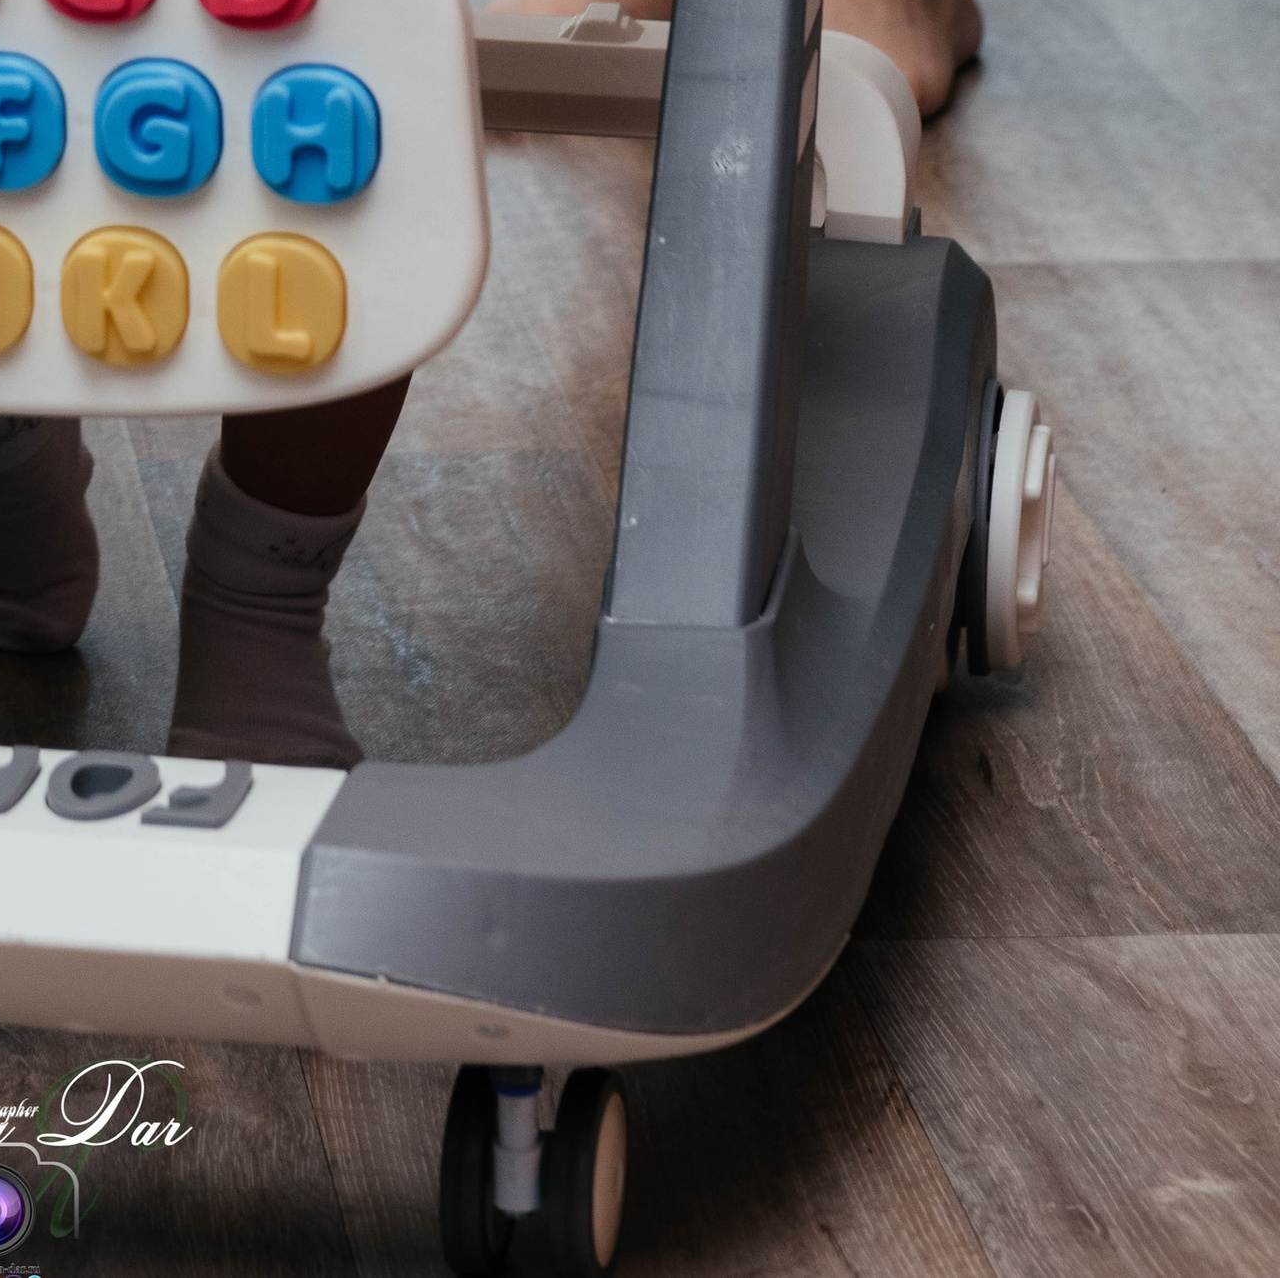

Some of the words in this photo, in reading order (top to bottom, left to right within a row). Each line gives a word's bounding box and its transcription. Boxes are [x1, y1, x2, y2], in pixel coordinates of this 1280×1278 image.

[98, 76, 190, 183] G
[261, 85, 354, 191] H
[74, 247, 157, 355] K
[247, 252, 312, 361] L
